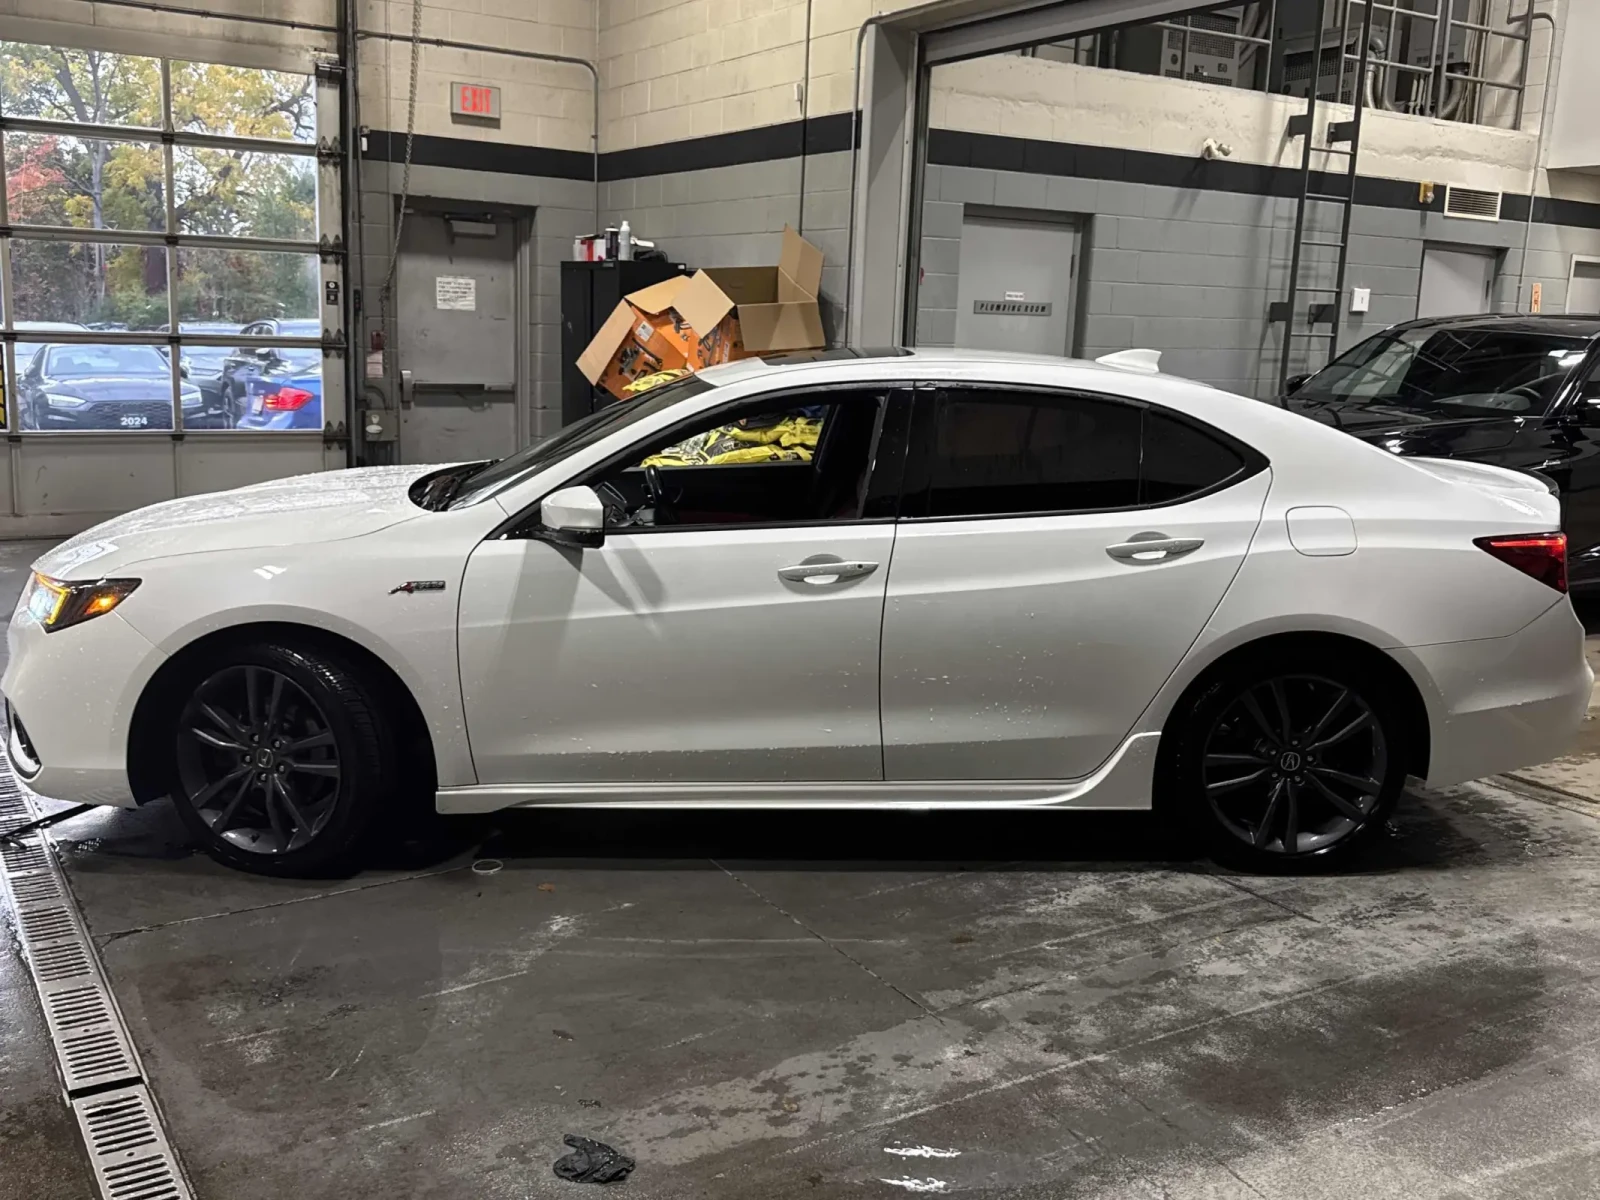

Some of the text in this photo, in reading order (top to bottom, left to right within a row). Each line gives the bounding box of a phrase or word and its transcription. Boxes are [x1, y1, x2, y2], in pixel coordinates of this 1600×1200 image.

[461, 85, 492, 114] EXIT
[980, 303, 1046, 313] PLUMBING ROOM
[120, 416, 148, 426] 2024
